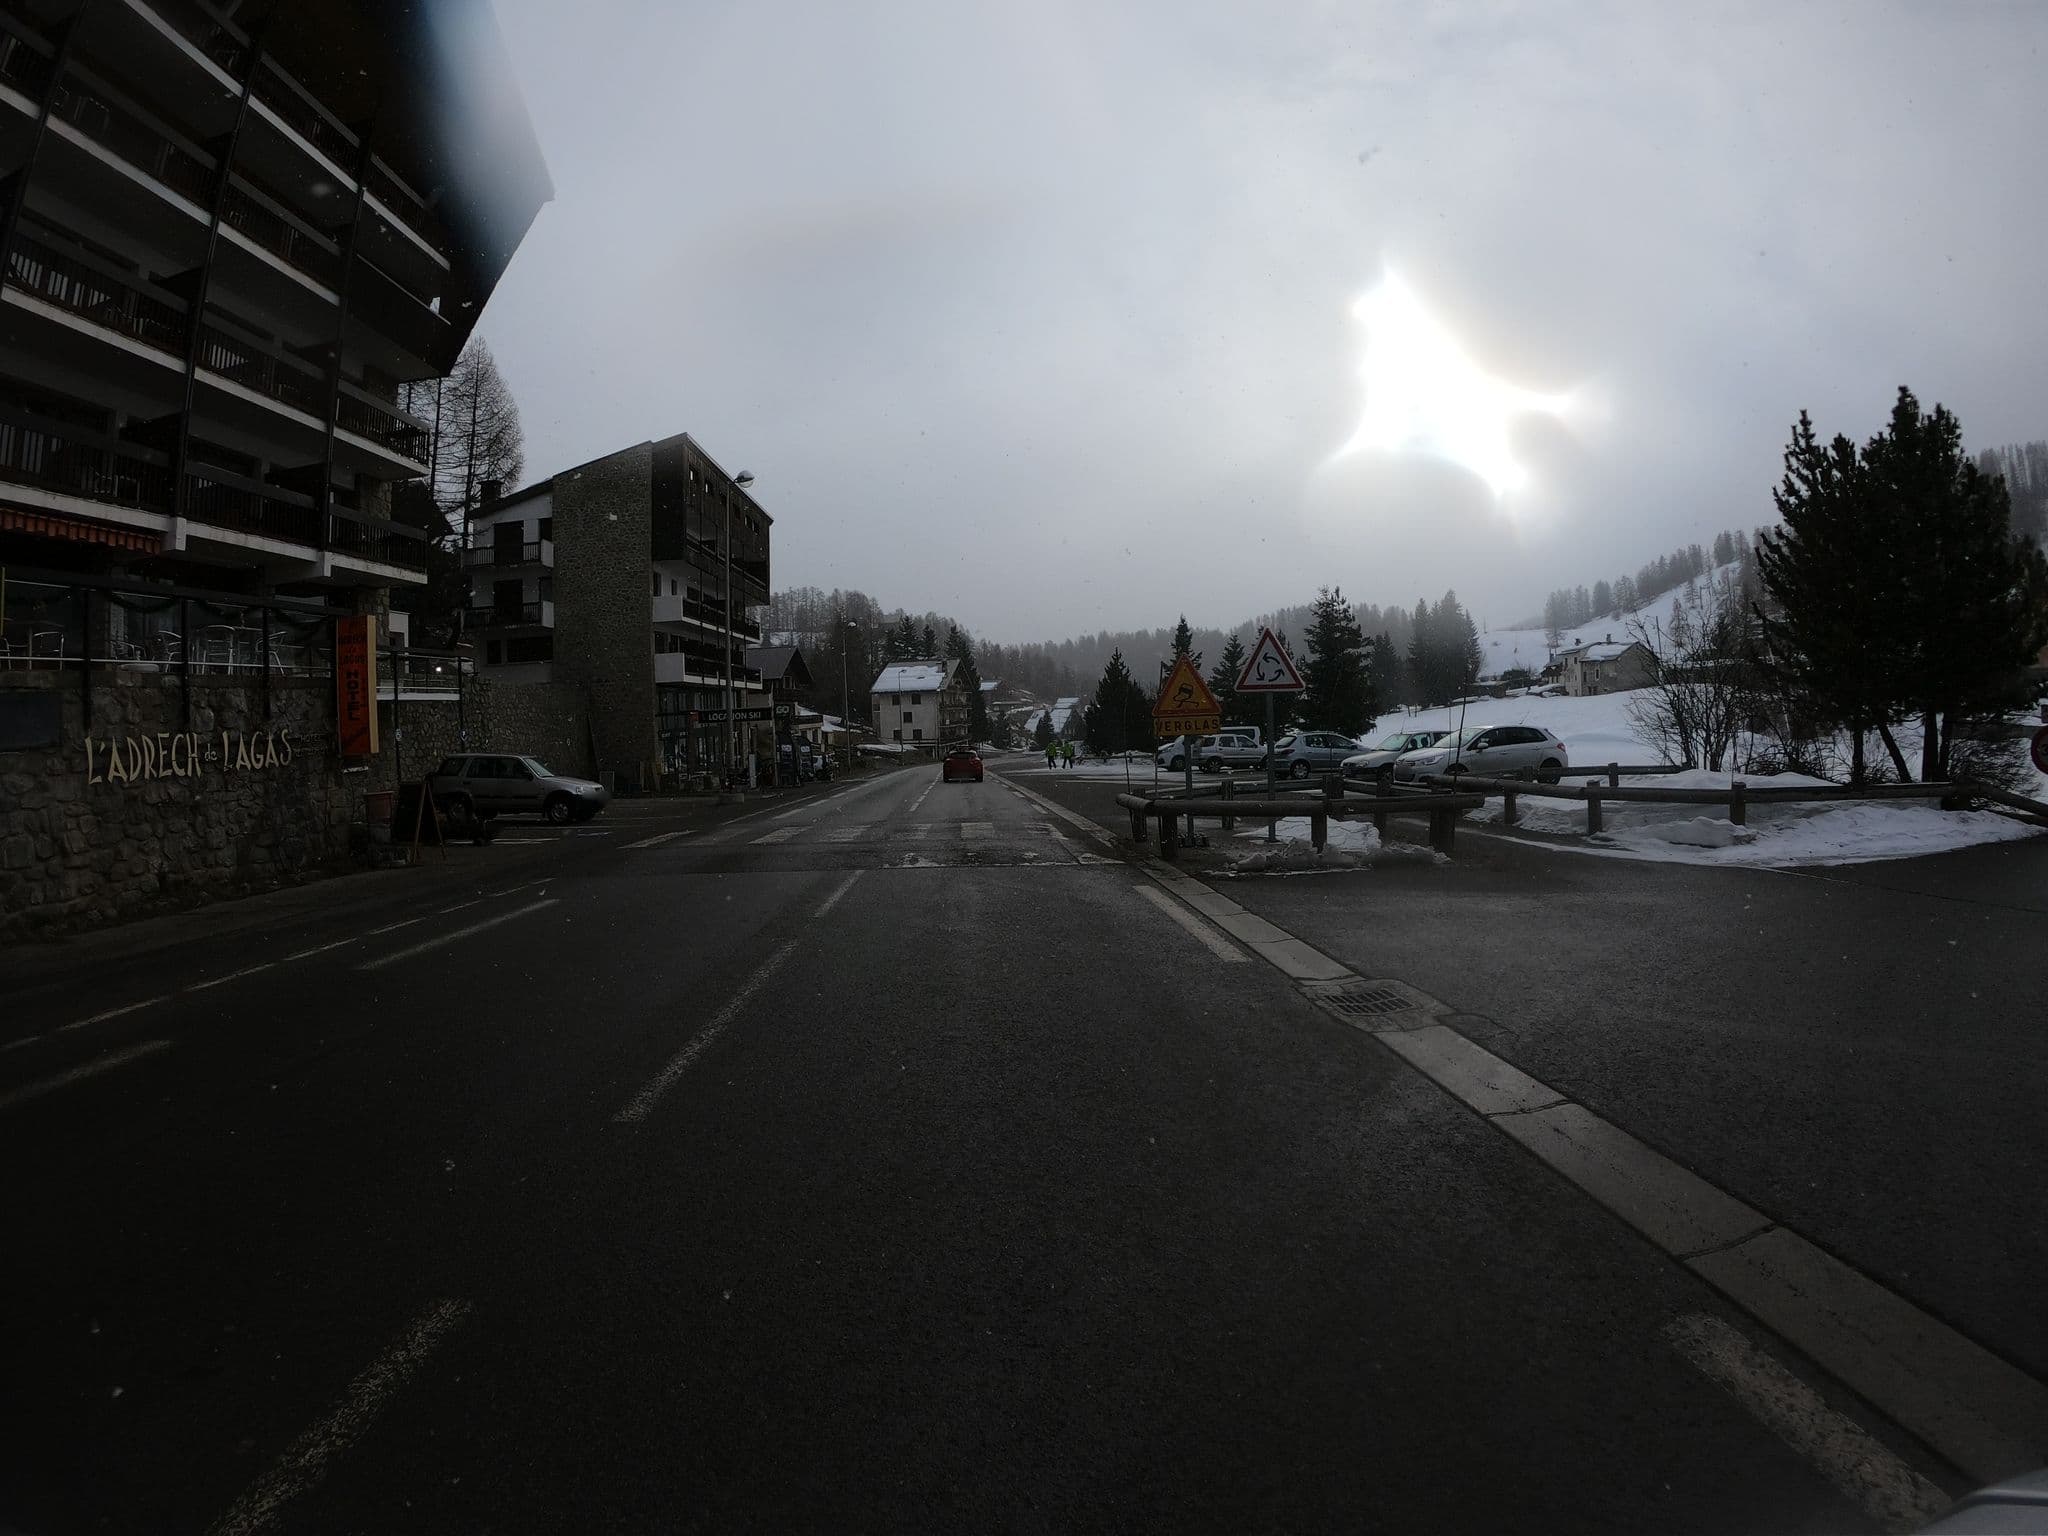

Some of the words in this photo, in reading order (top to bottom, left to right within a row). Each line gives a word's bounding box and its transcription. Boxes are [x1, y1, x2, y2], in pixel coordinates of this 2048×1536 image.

[749, 711, 761, 719] SKI
[1157, 719, 1219, 732] VERGLAS
[84, 732, 201, 785] L'ADRECH
[204, 743, 218, 762] de
[222, 728, 292, 772] LAGAS
